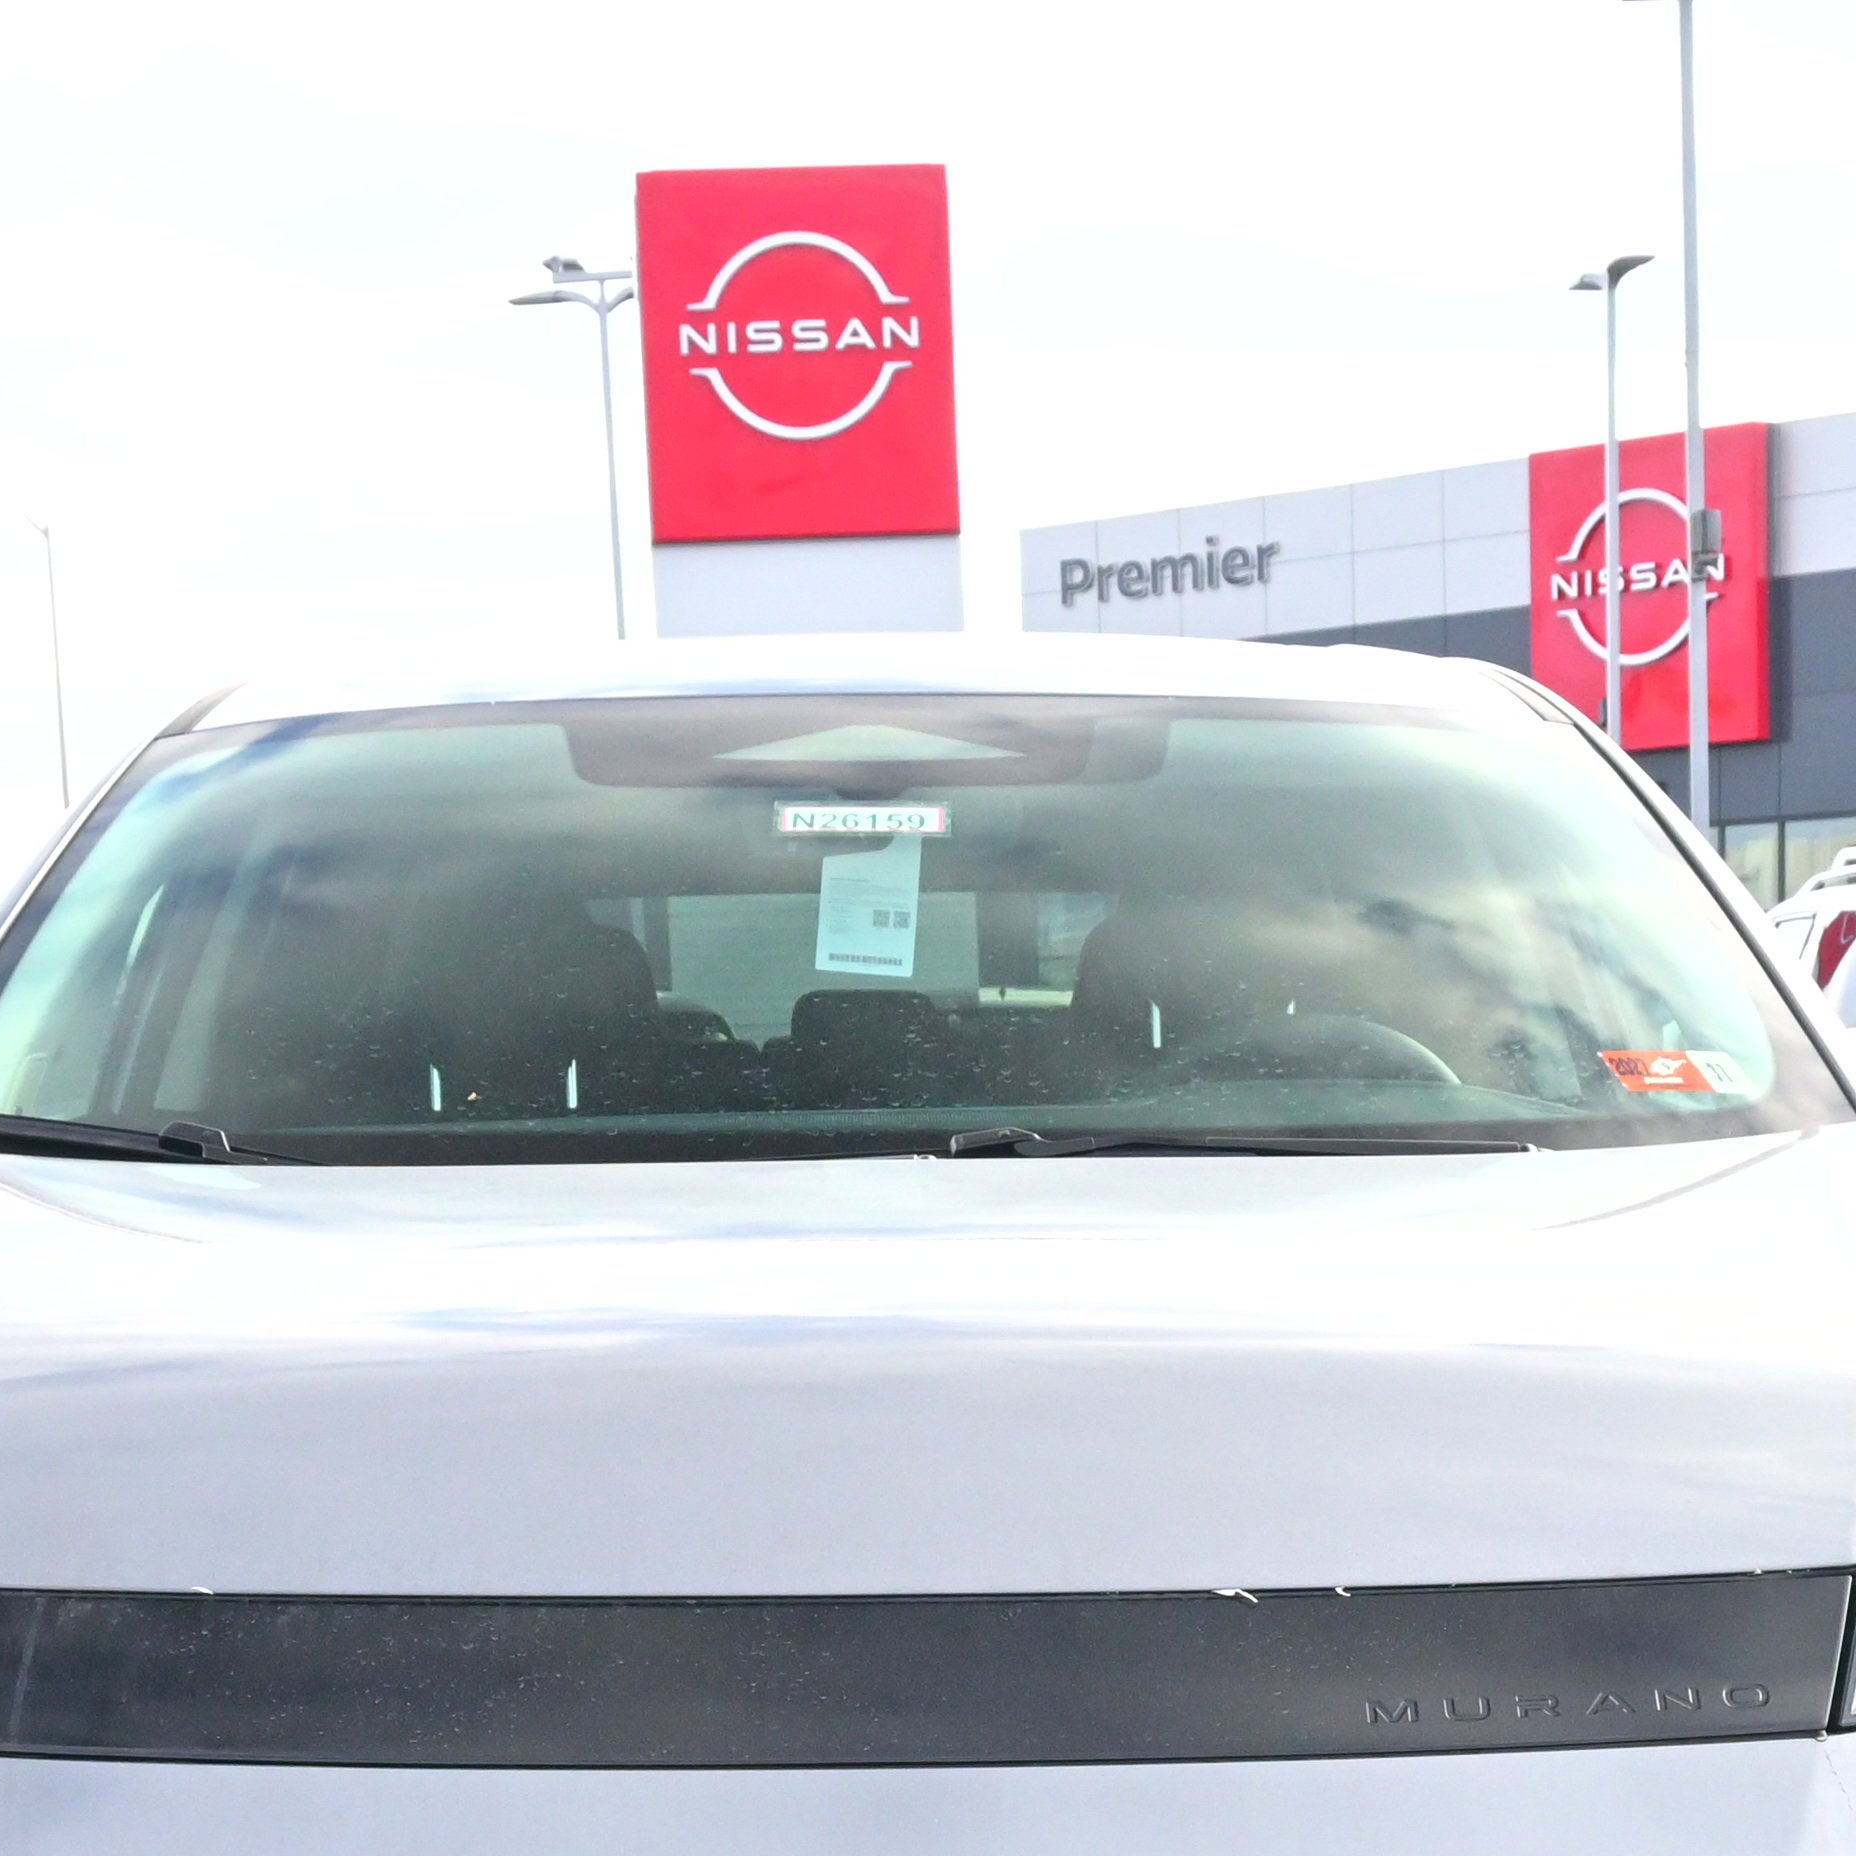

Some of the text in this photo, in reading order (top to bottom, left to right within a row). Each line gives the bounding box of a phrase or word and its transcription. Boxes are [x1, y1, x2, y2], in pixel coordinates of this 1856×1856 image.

[679, 316, 920, 356] NISSAN
[1060, 535, 1280, 608] Premier
[792, 812, 925, 830] N26159
[1366, 1682, 1770, 1724] MURANO
